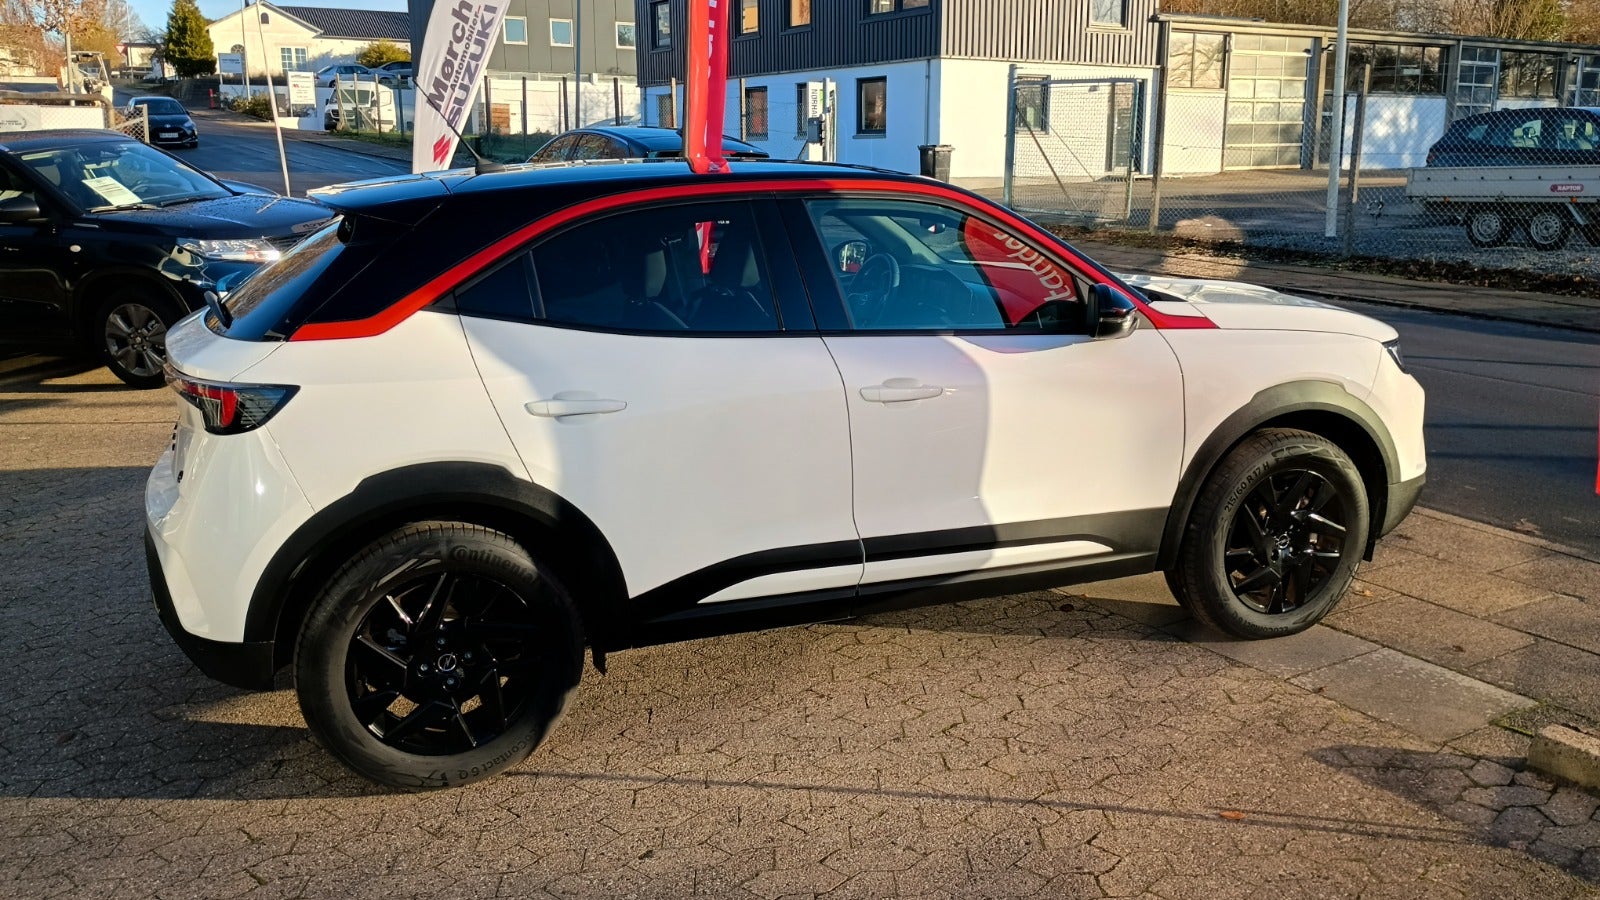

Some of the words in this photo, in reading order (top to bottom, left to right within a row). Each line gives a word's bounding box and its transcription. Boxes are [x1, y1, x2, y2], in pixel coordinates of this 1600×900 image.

[427, 0, 474, 111] Mørch
[447, 4, 498, 128] SUZUKI
[450, 11, 481, 93] Automobiler
[1224, 481, 1247, 512] 215/60
[1246, 474, 1254, 484] R
[1252, 467, 1261, 477] 17
[1262, 461, 1270, 471] H
[450, 544, 537, 584] Continenta
[482, 728, 537, 772] coContact
